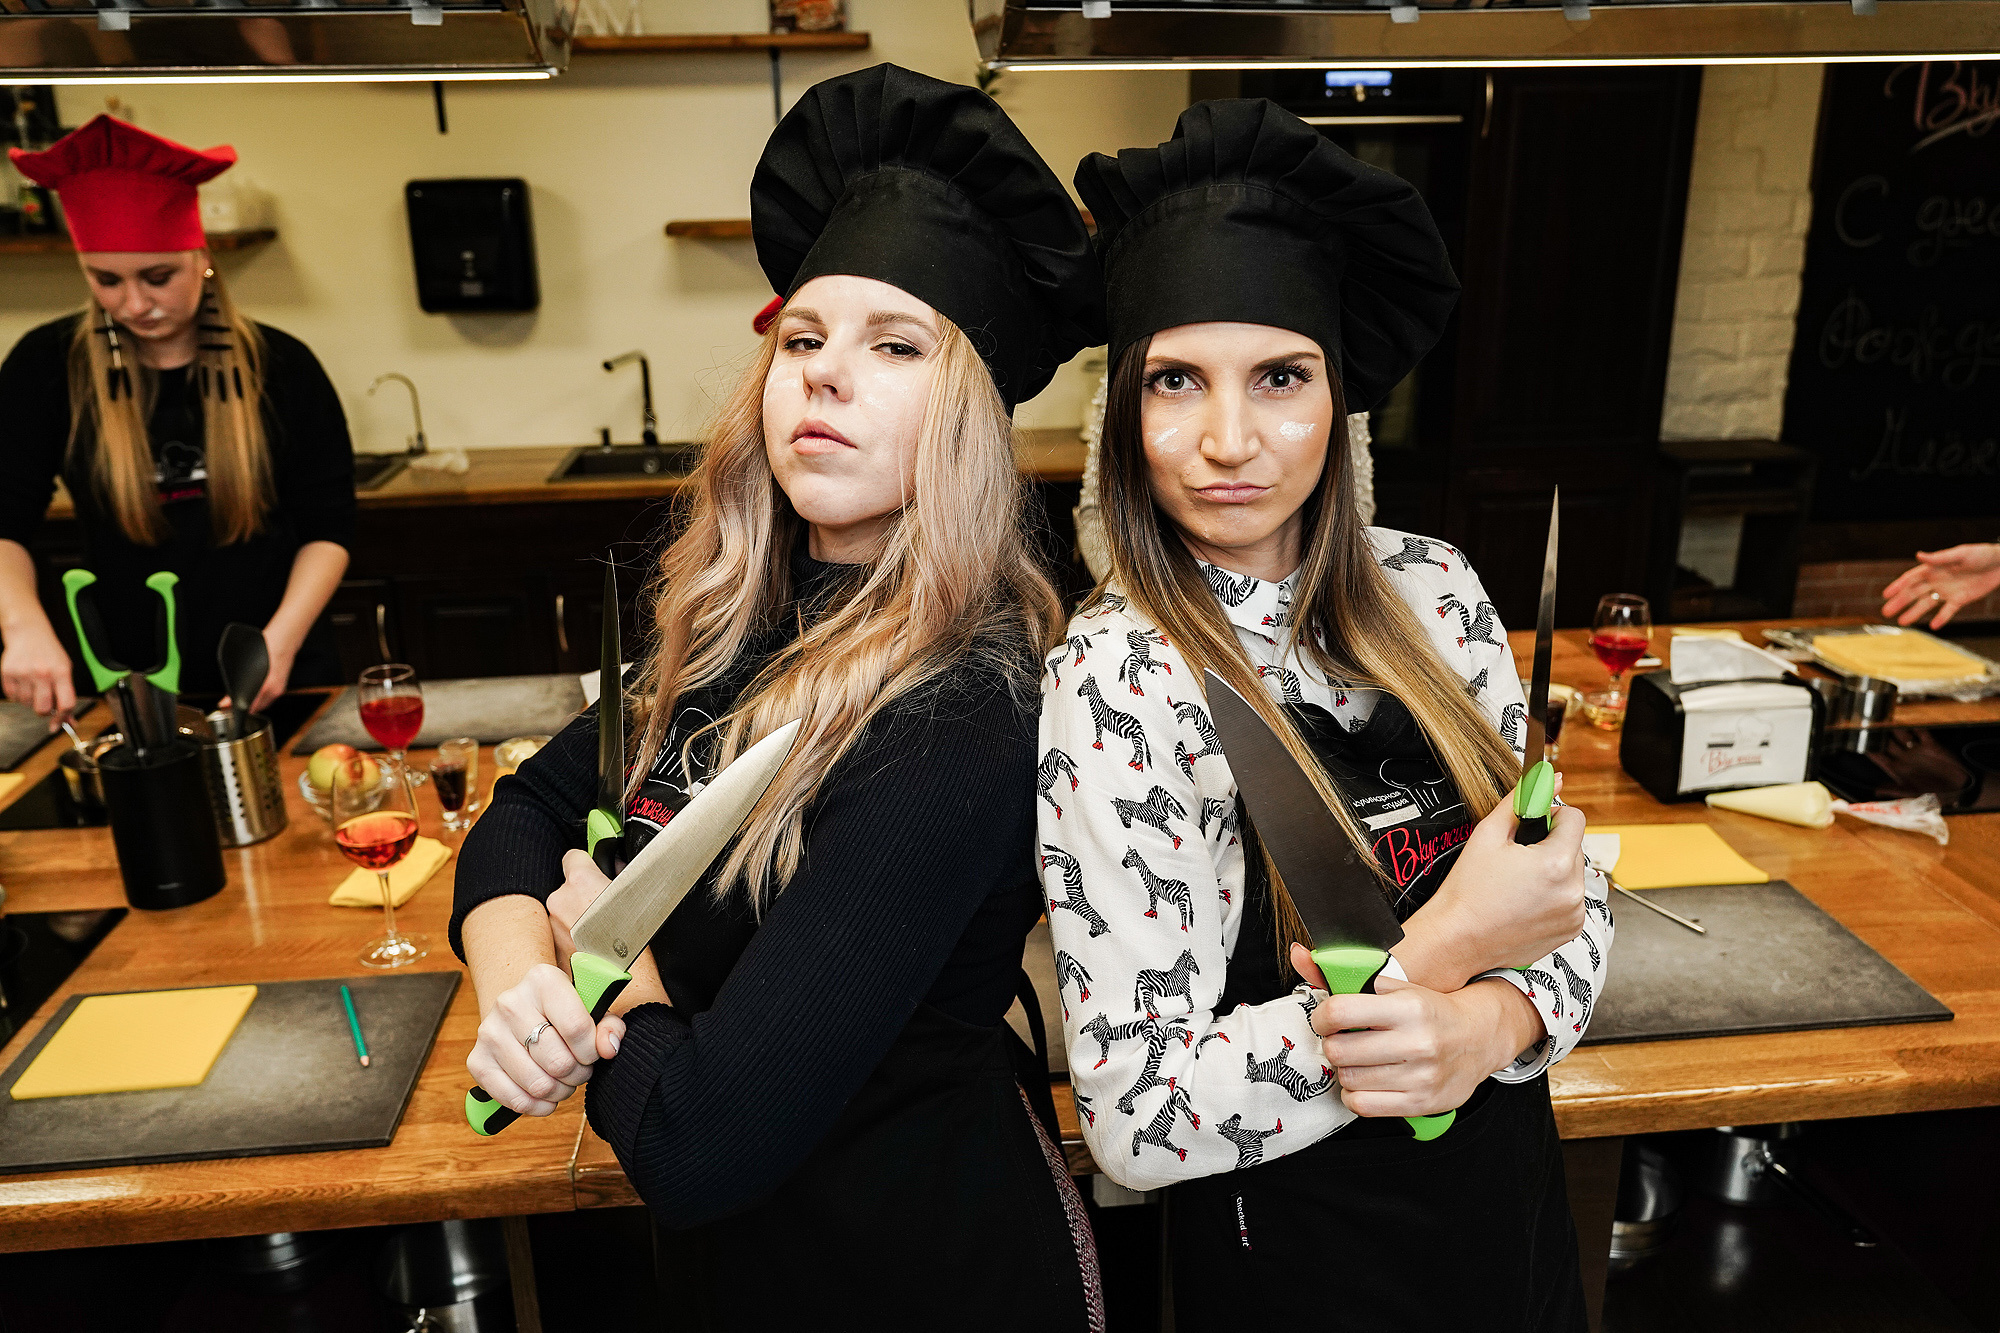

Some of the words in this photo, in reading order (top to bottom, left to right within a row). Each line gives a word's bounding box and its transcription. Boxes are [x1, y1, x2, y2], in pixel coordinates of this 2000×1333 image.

[1882, 63, 2000, 138] Вку
[1834, 174, 1890, 249] С
[1848, 404, 2000, 483] Алён
[1381, 798, 1410, 810] студия
[1372, 827, 1440, 887] Вкус
[1440, 821, 1474, 851] жиз
